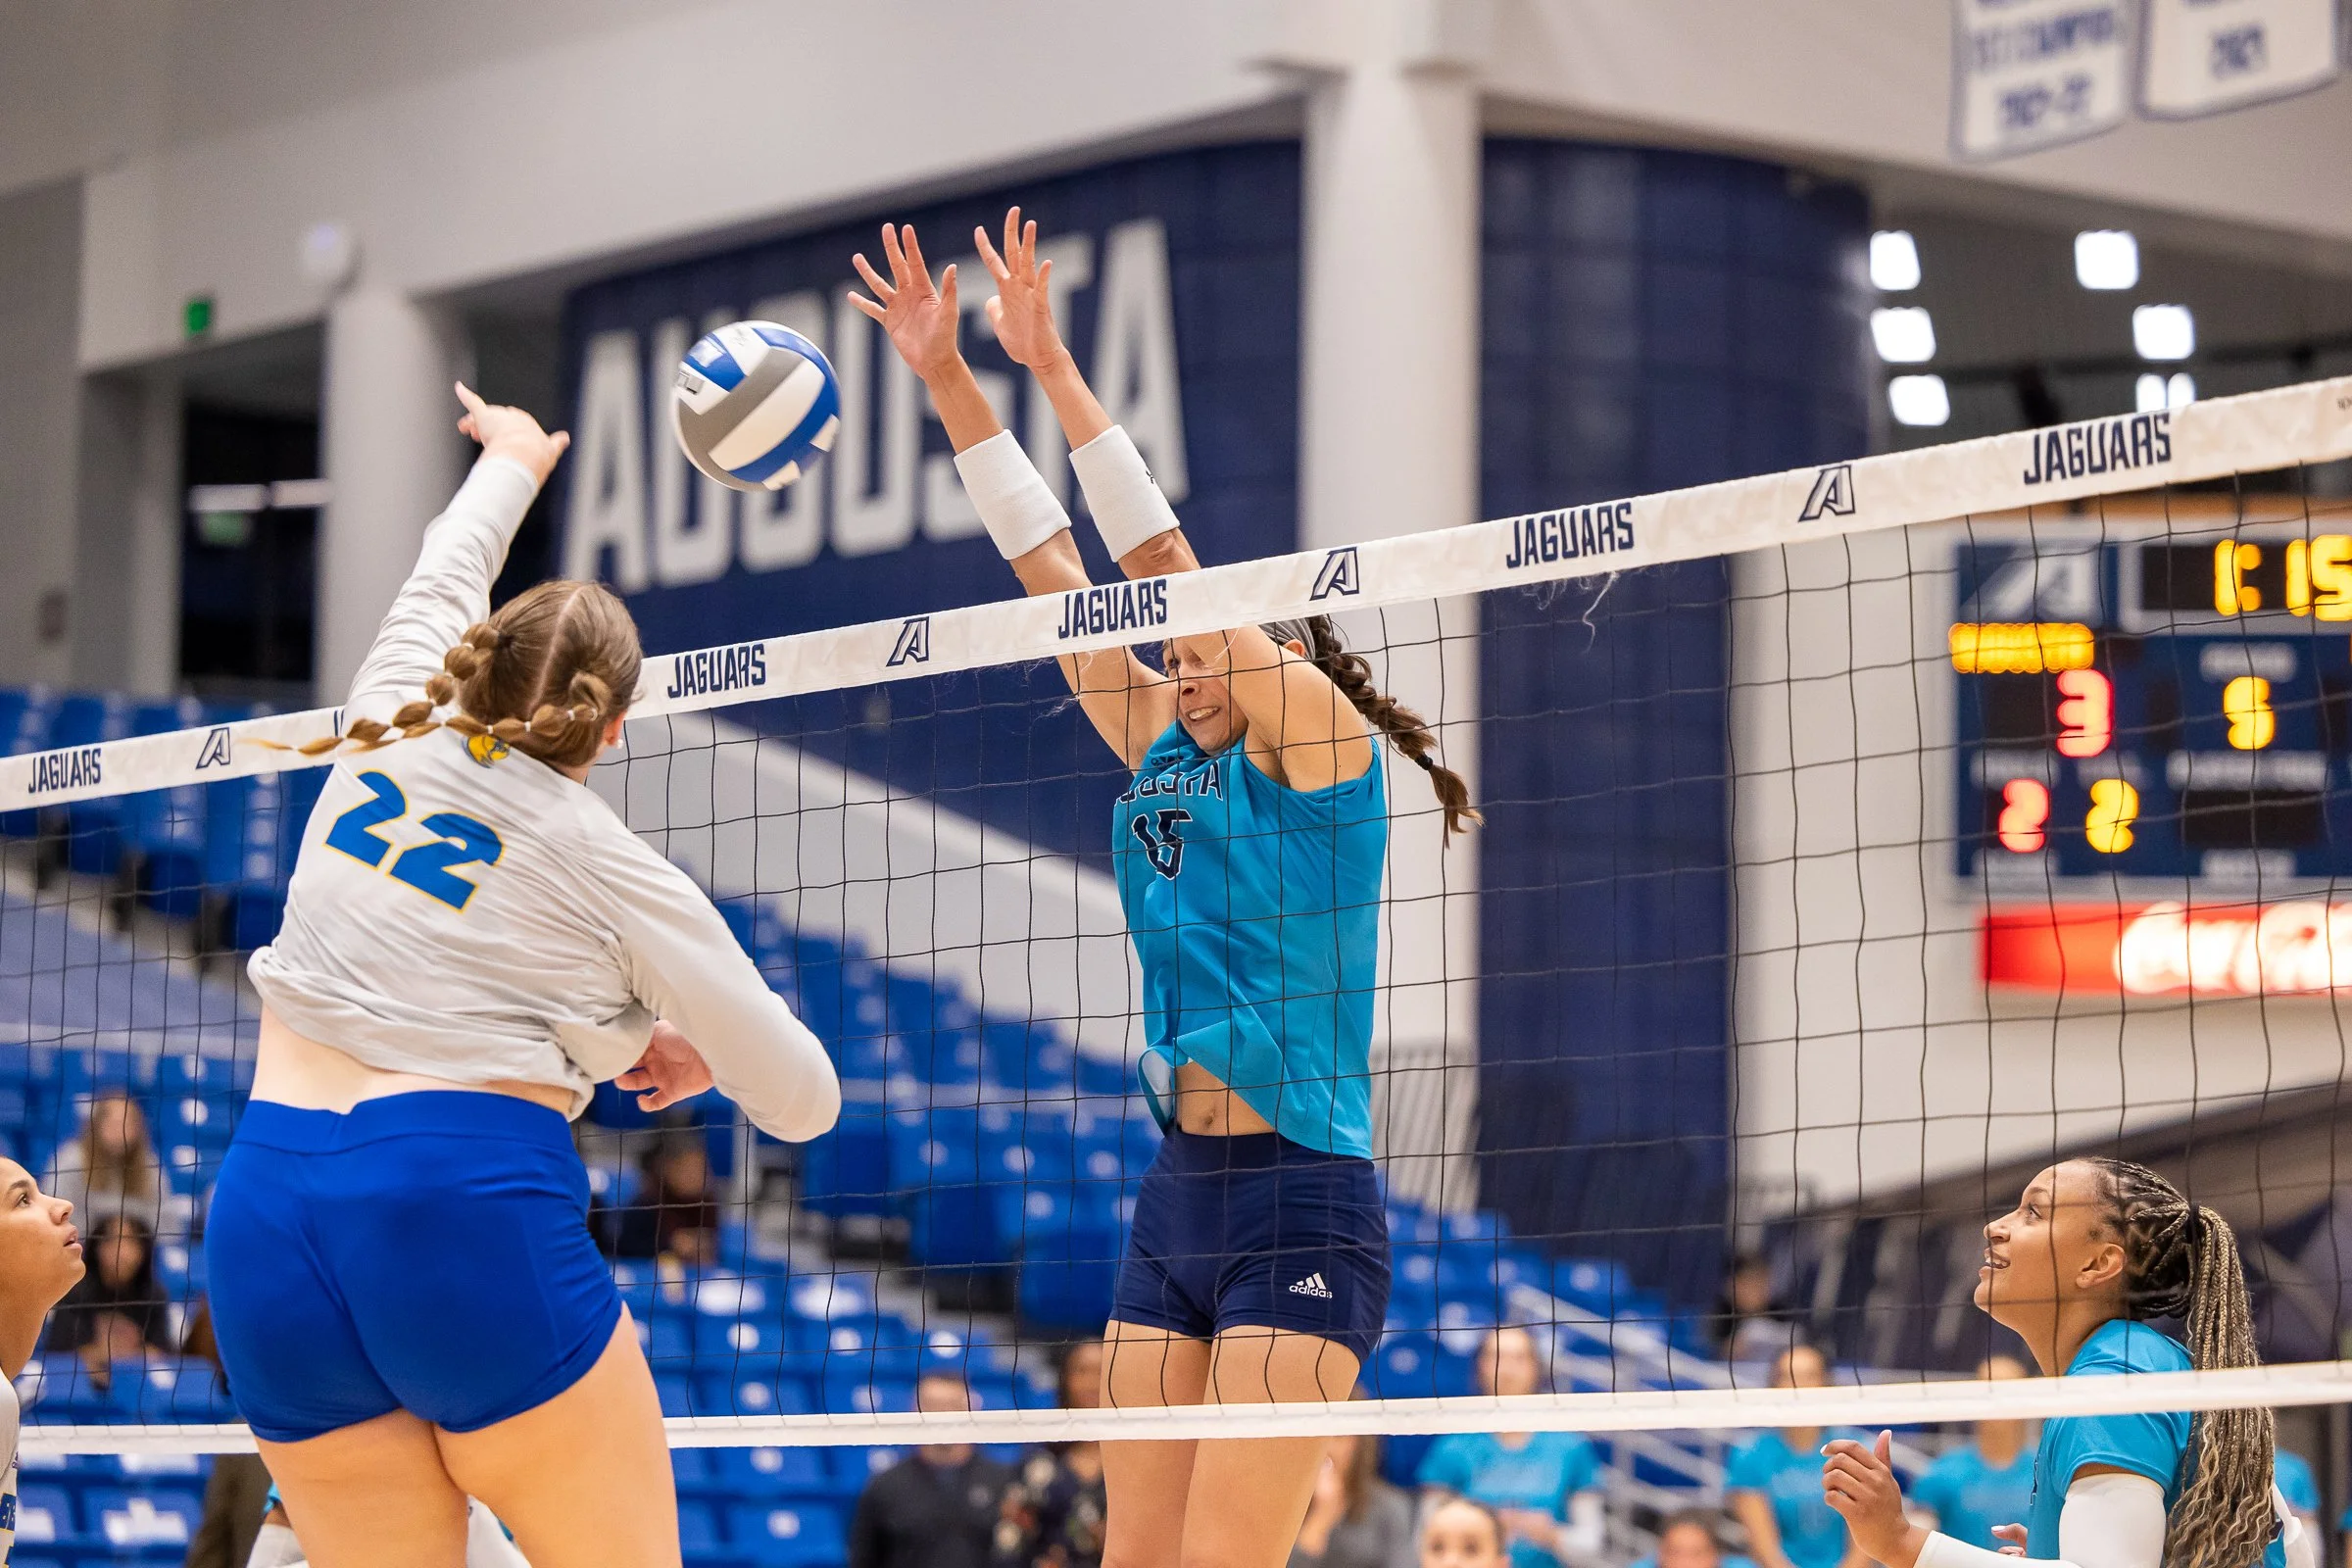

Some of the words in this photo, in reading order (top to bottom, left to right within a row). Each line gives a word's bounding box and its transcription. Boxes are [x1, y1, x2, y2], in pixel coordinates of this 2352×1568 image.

[28, 748, 102, 794] JAGUARS
[667, 643, 766, 698] JAGUARS
[1058, 579, 1168, 639] JAGUARS
[1506, 502, 1635, 569] JAGUARS
[2024, 412, 2171, 485] JAGUARS
[2057, 668, 2114, 758] 3
[321, 768, 506, 914] 22
[1131, 808, 1193, 881] 15
[1289, 1284, 1333, 1299] adidas
